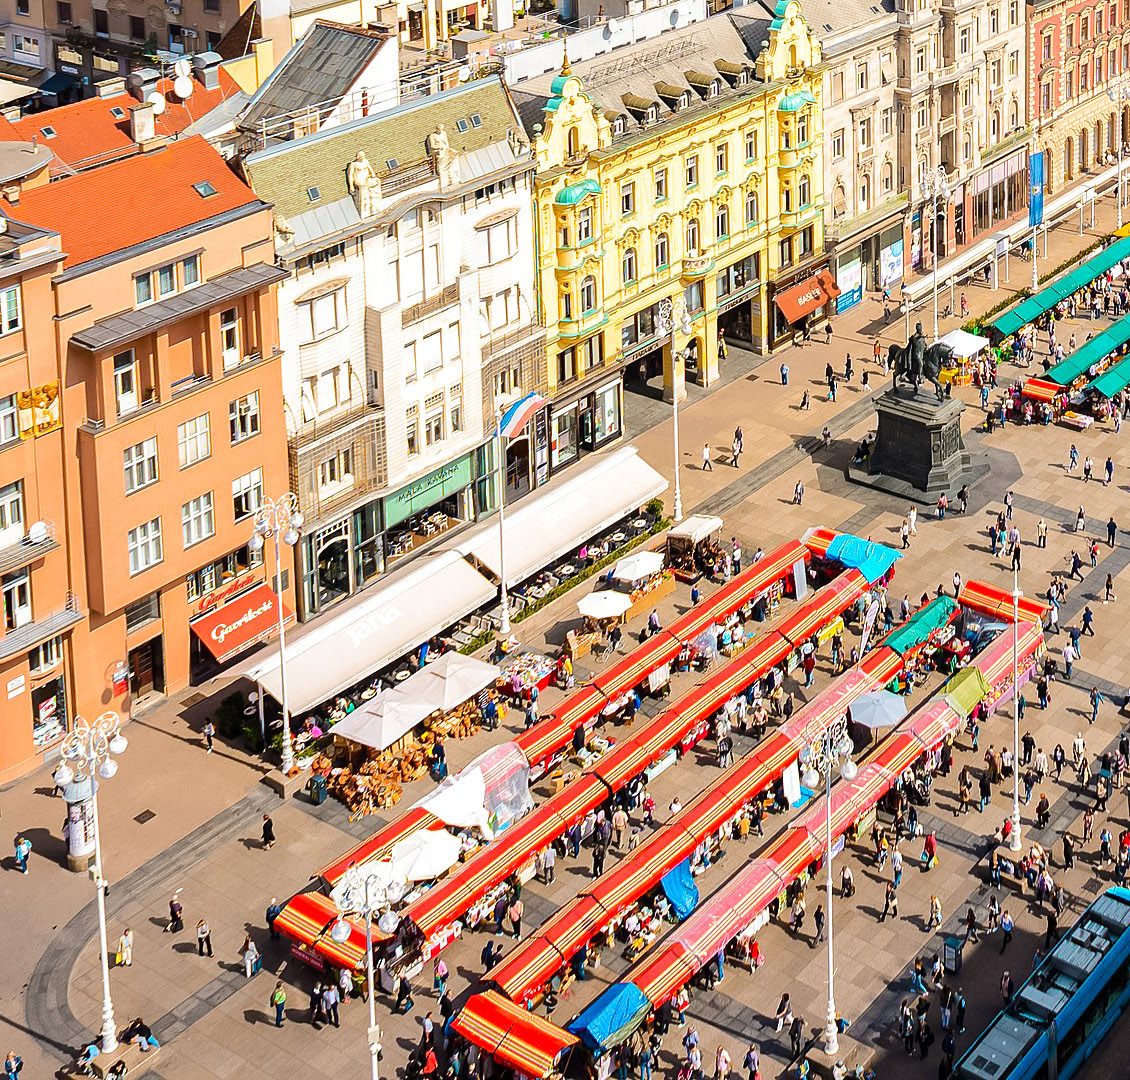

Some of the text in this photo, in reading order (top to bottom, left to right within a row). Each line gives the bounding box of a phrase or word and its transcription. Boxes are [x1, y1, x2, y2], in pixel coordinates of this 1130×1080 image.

[797, 287, 822, 306] BASLER
[398, 464, 459, 502] MALA KAVANA
